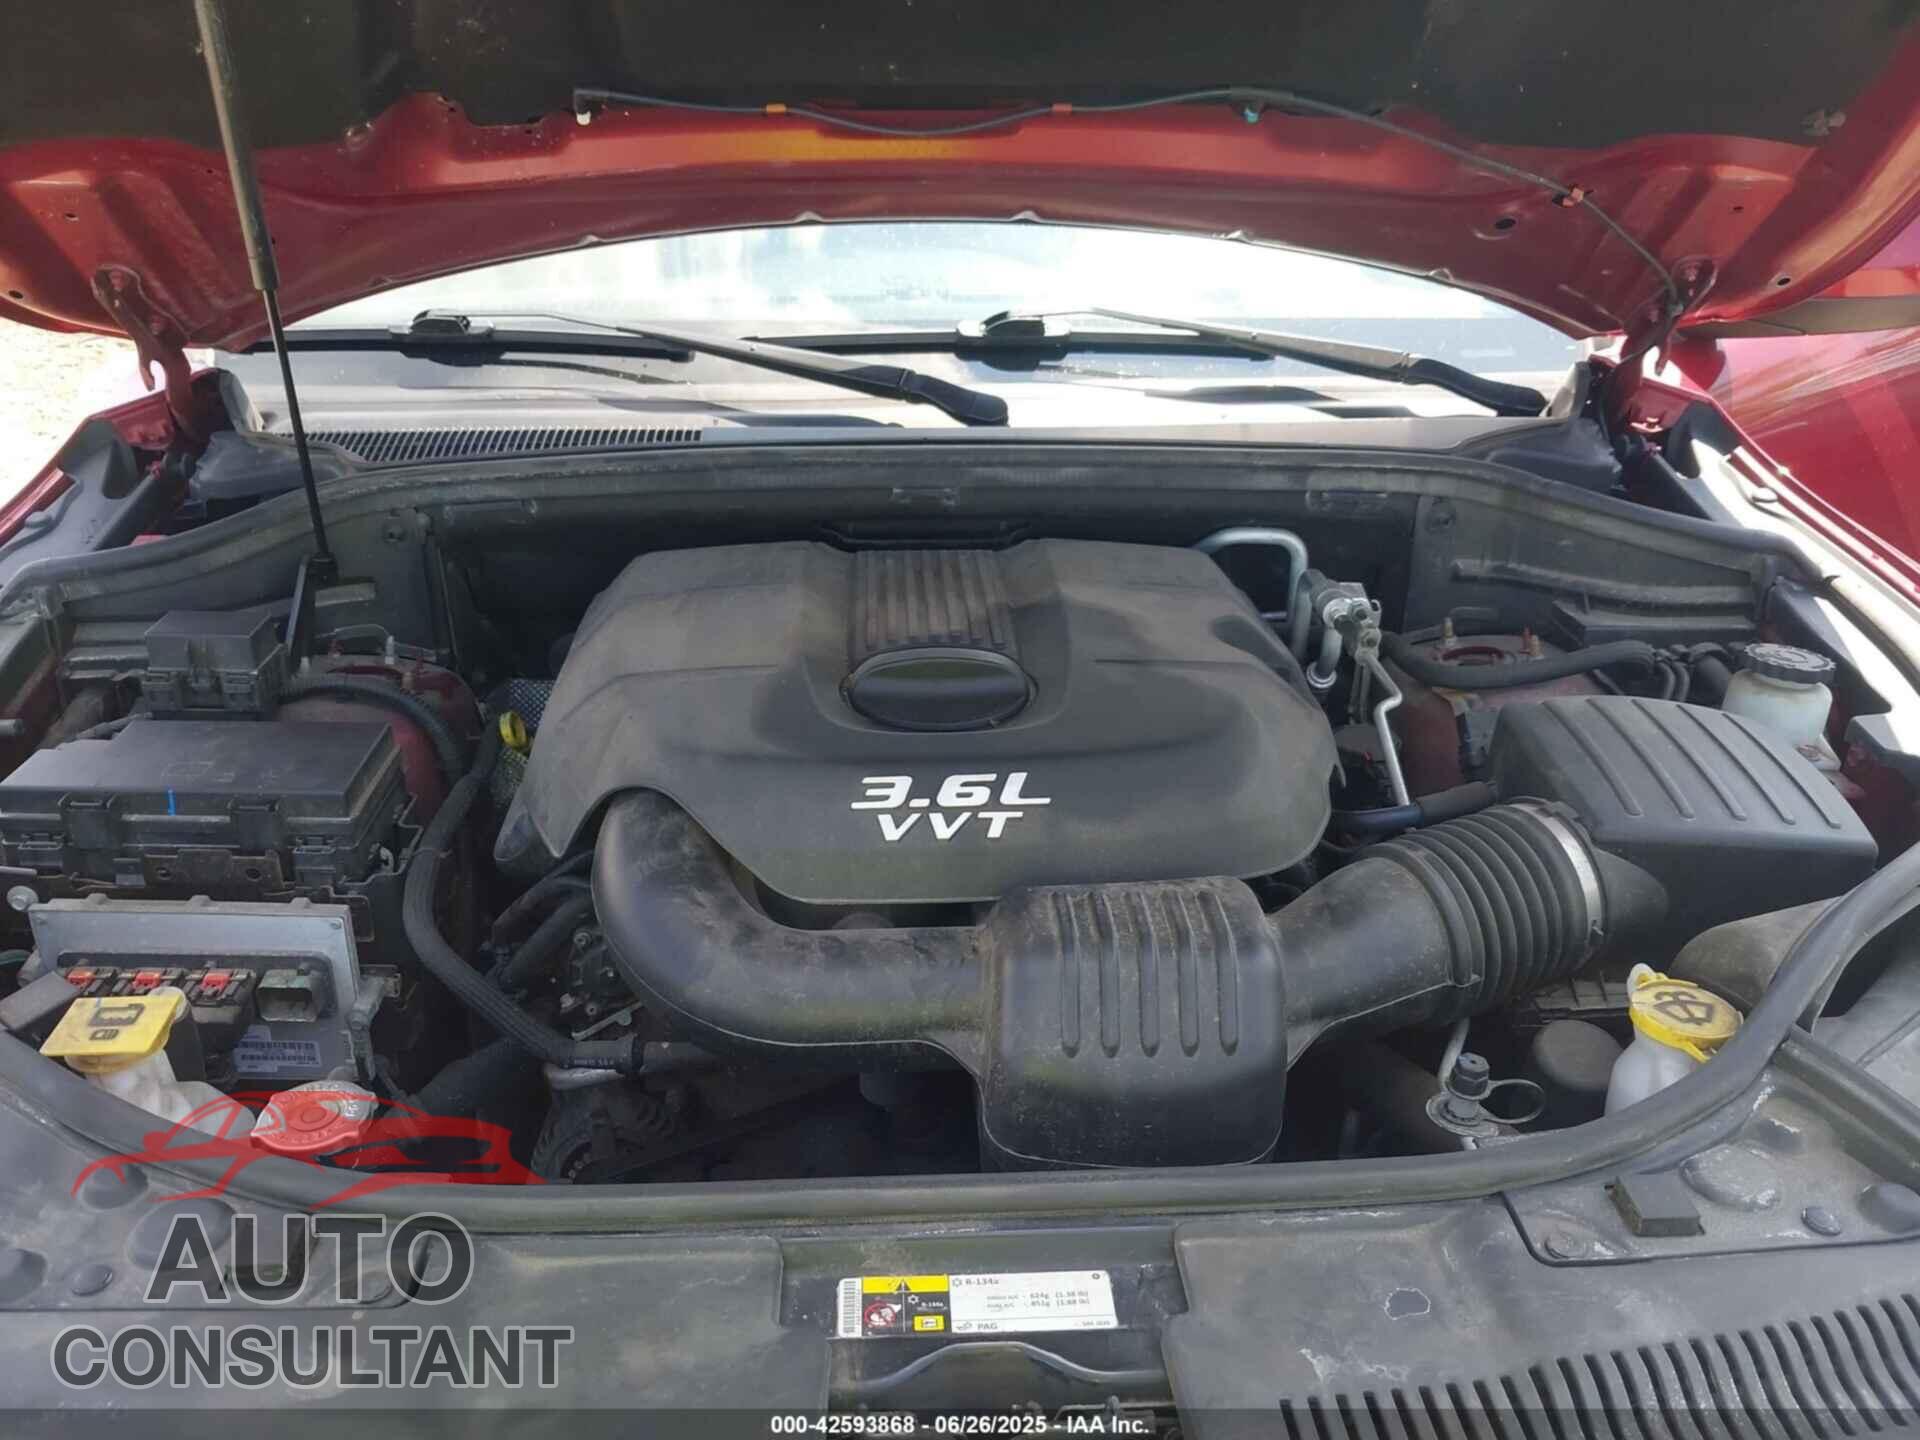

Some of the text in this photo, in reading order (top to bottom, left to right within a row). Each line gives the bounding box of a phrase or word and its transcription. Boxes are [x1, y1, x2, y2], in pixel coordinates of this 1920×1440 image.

[851, 772, 1051, 809] 3.6L
[877, 811, 1024, 841] VVT
[977, 1321, 998, 1331] PAG
